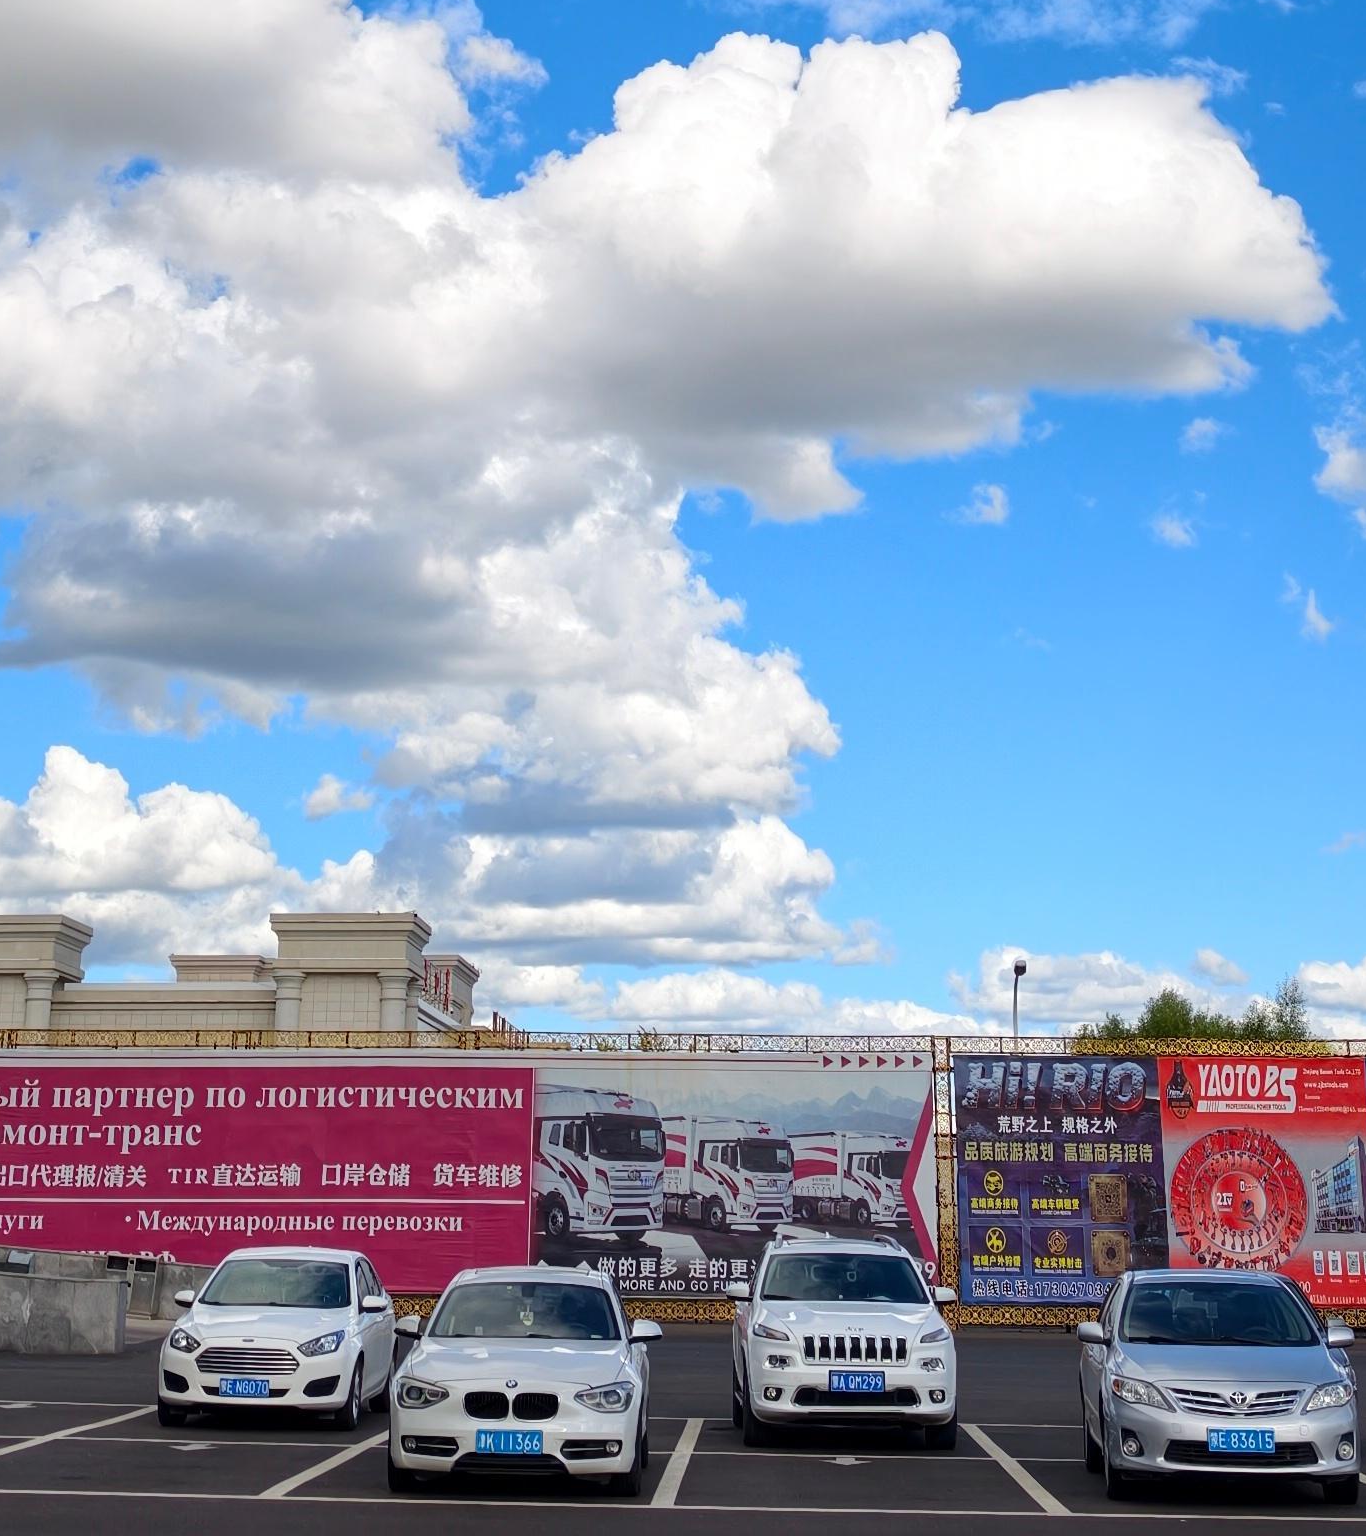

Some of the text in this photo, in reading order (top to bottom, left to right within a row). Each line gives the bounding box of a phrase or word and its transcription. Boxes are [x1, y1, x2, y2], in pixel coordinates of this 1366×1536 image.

[1050, 1062, 1146, 1110] RIO
[1198, 1064, 1260, 1097] YAOTO
[52, 1085, 195, 1116] партнер
[205, 1087, 246, 1109] по
[255, 1086, 524, 1110] логистическим
[997, 1116, 1117, 1134] 荒野之上 规格之外
[964, 1141, 1153, 1162] 品质旅游规划 高端商务接待
[168, 1164, 301, 1187] TIR直达运输
[321, 1163, 411, 1187] 口岸仓储
[433, 1164, 523, 1188] 货车维修
[136, 1210, 463, 1236] Международные перевозки
[598, 1256, 757, 1279] 做的更多 走的更
[619, 1280, 655, 1291] MORE
[659, 1280, 686, 1291] AND
[690, 1280, 708, 1292] GO
